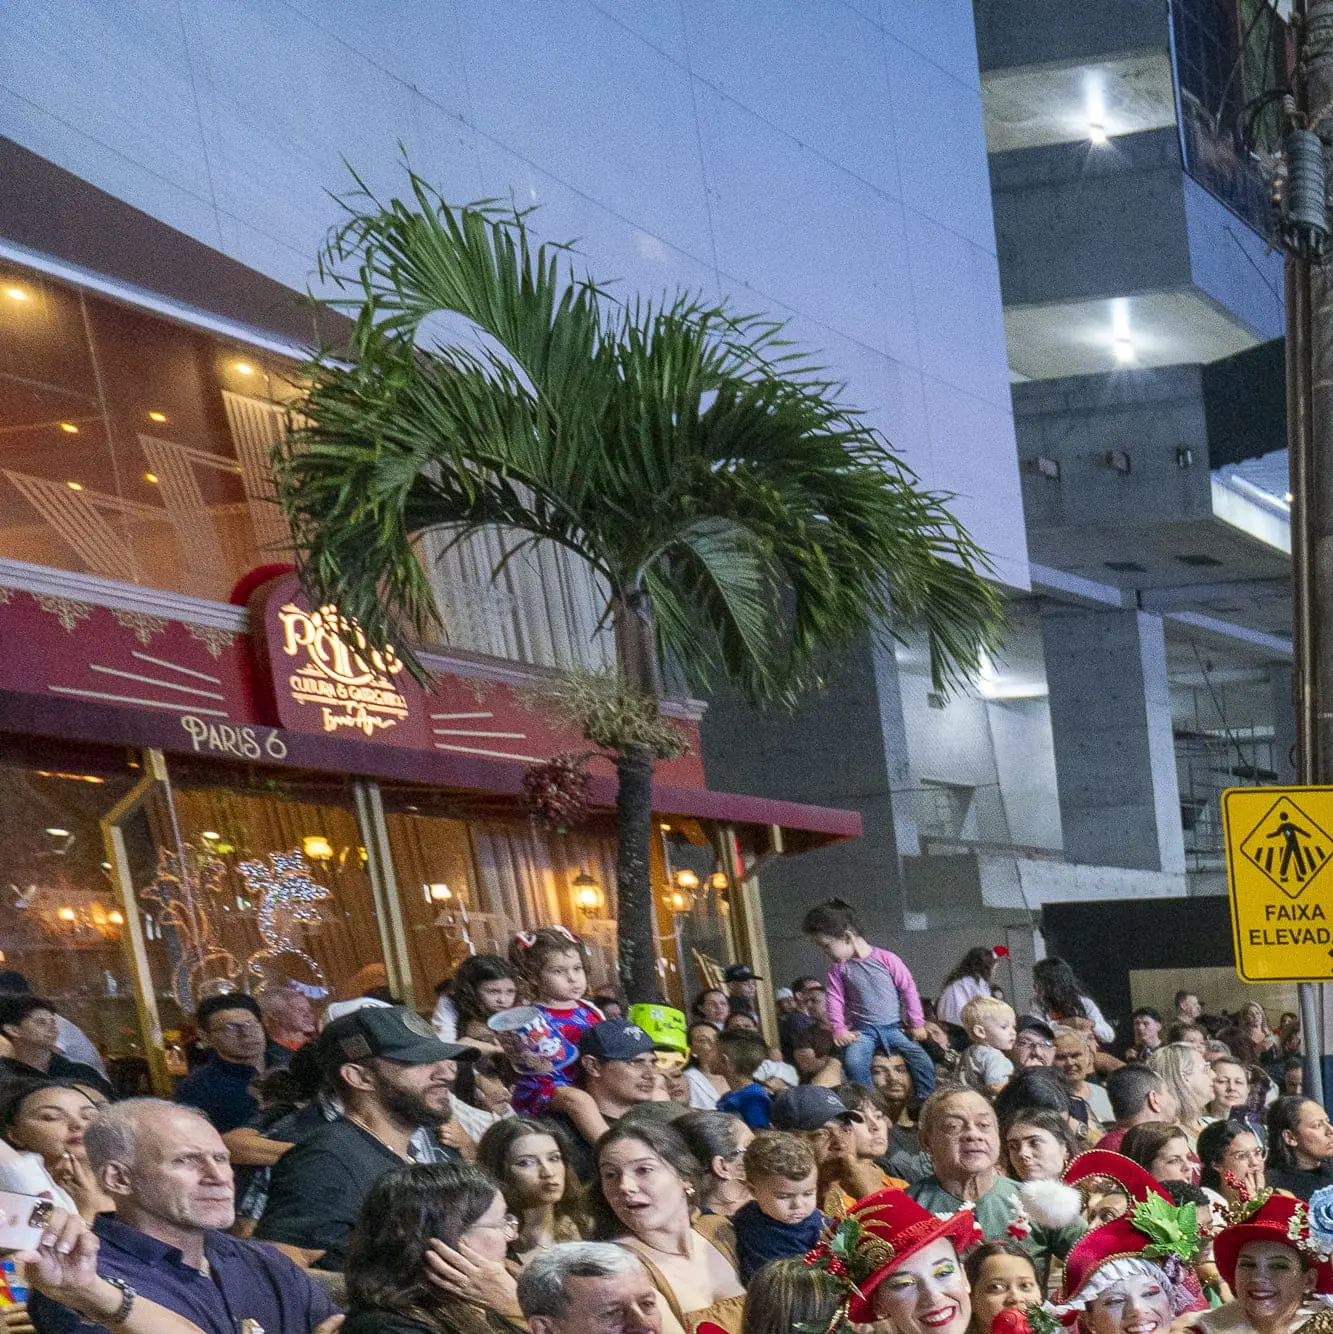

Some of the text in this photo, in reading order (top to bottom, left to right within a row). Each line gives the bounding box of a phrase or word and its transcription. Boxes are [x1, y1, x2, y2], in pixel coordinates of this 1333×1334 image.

[180, 715, 288, 760] PARIS 6
[1265, 903, 1326, 922] FAIXA
